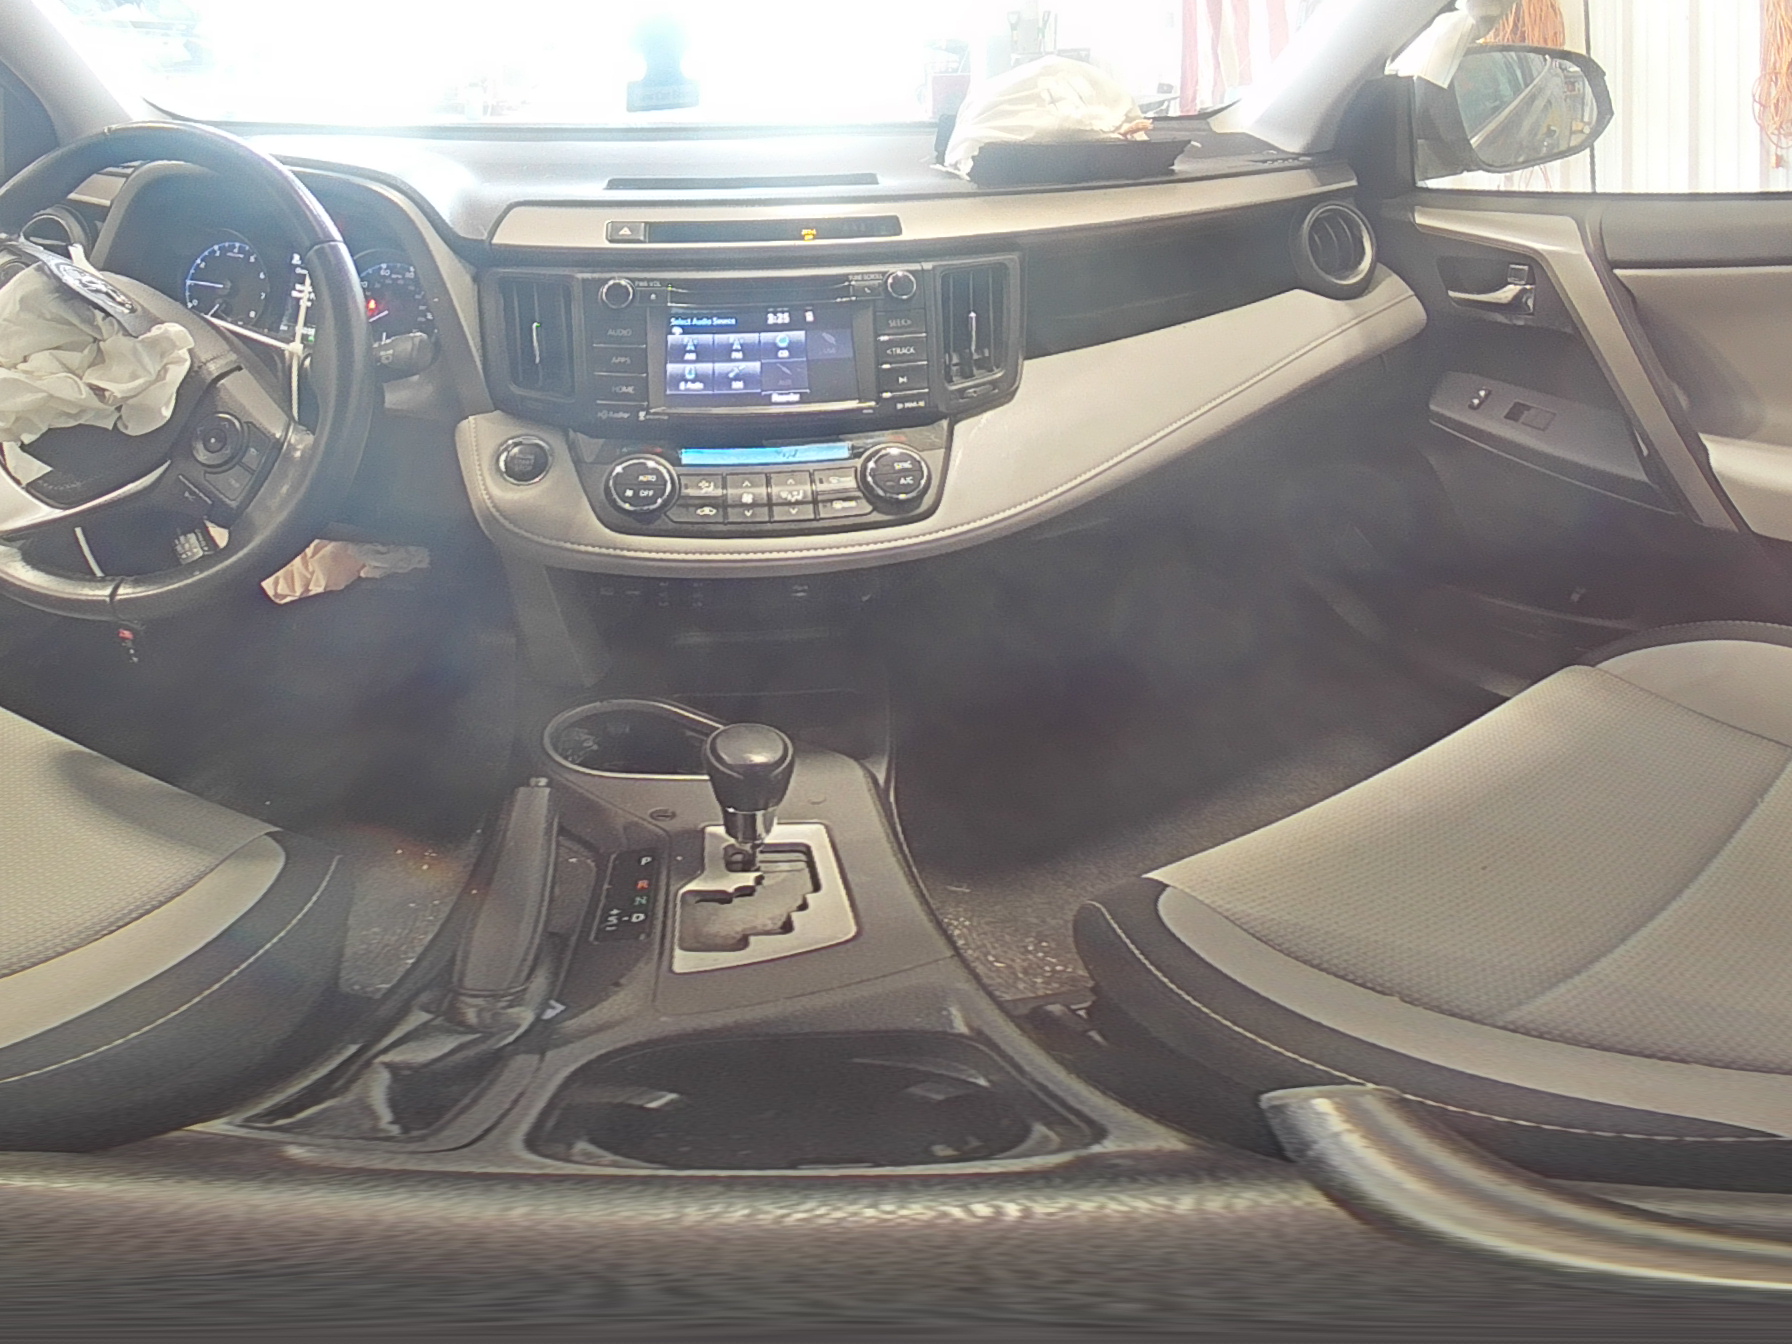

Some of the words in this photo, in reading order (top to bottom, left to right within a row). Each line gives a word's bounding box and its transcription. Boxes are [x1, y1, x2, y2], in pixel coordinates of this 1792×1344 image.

[670, 317, 691, 327] Select
[692, 317, 712, 326] Audio
[607, 328, 632, 337] AUDIO
[892, 346, 916, 355] TRACK
[611, 356, 631, 365] APPS
[612, 385, 635, 394] HOME
[899, 476, 914, 485] A/C
[640, 856, 653, 866] P
[637, 880, 649, 890] R
[634, 896, 649, 906] N
[631, 913, 646, 923] D
